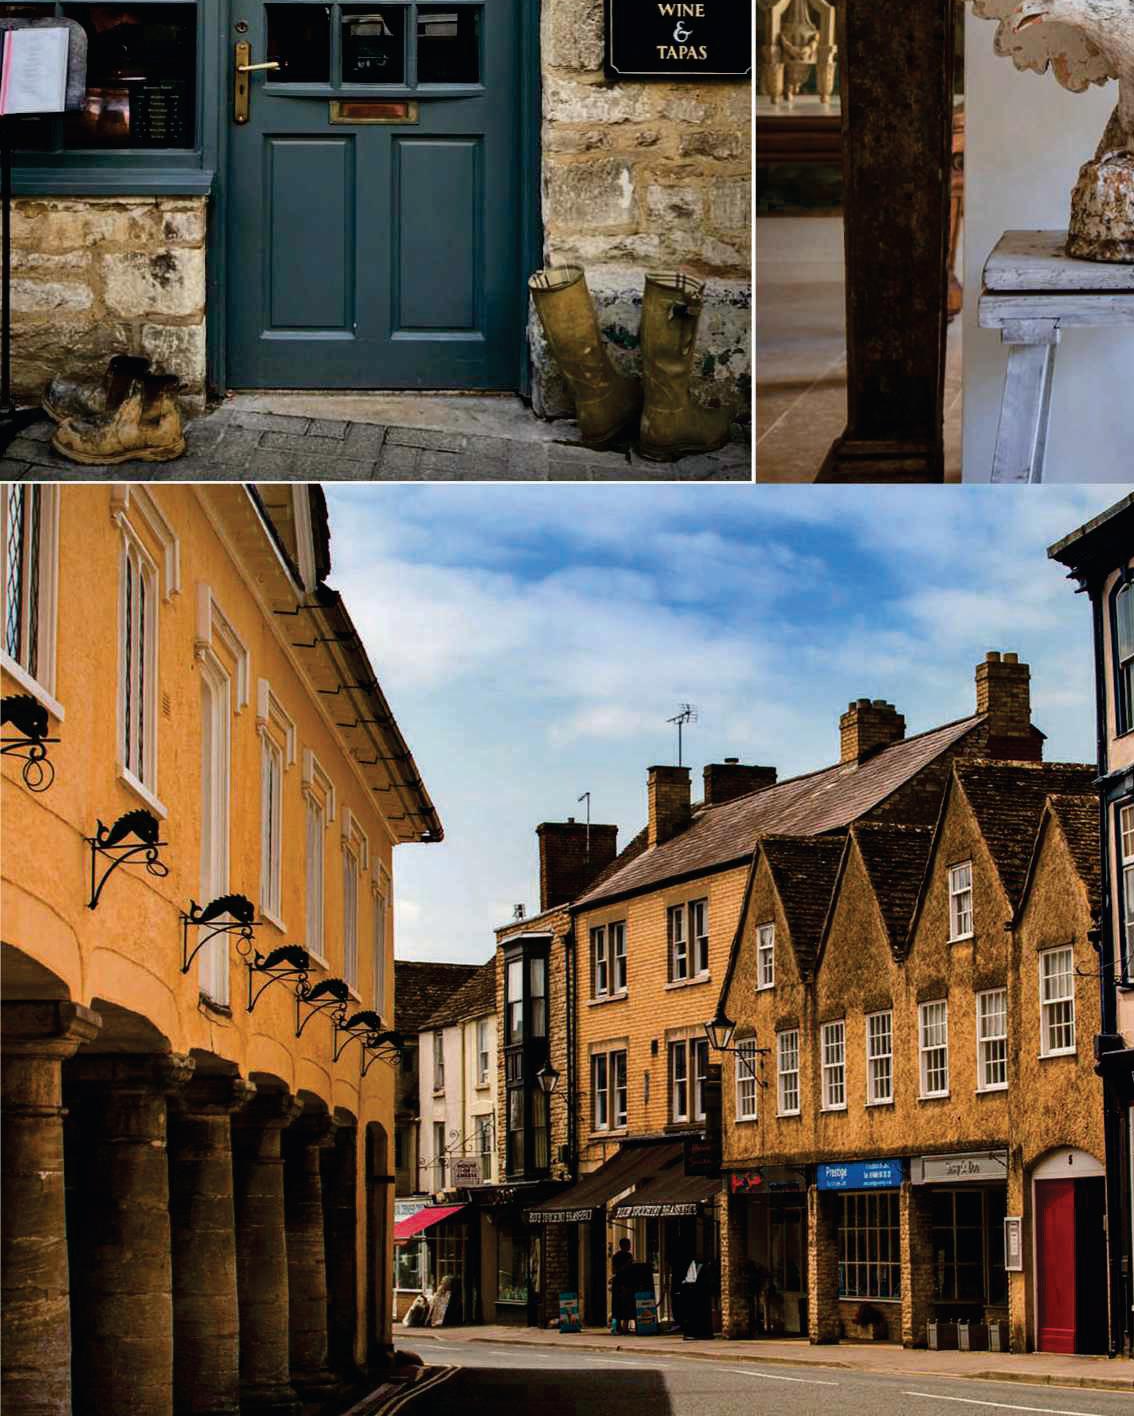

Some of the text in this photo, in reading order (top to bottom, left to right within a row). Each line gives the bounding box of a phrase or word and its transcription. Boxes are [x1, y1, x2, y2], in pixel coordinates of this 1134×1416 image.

[657, 3, 705, 17] WINE
[672, 20, 693, 42] &
[656, 45, 708, 60] TAPAS
